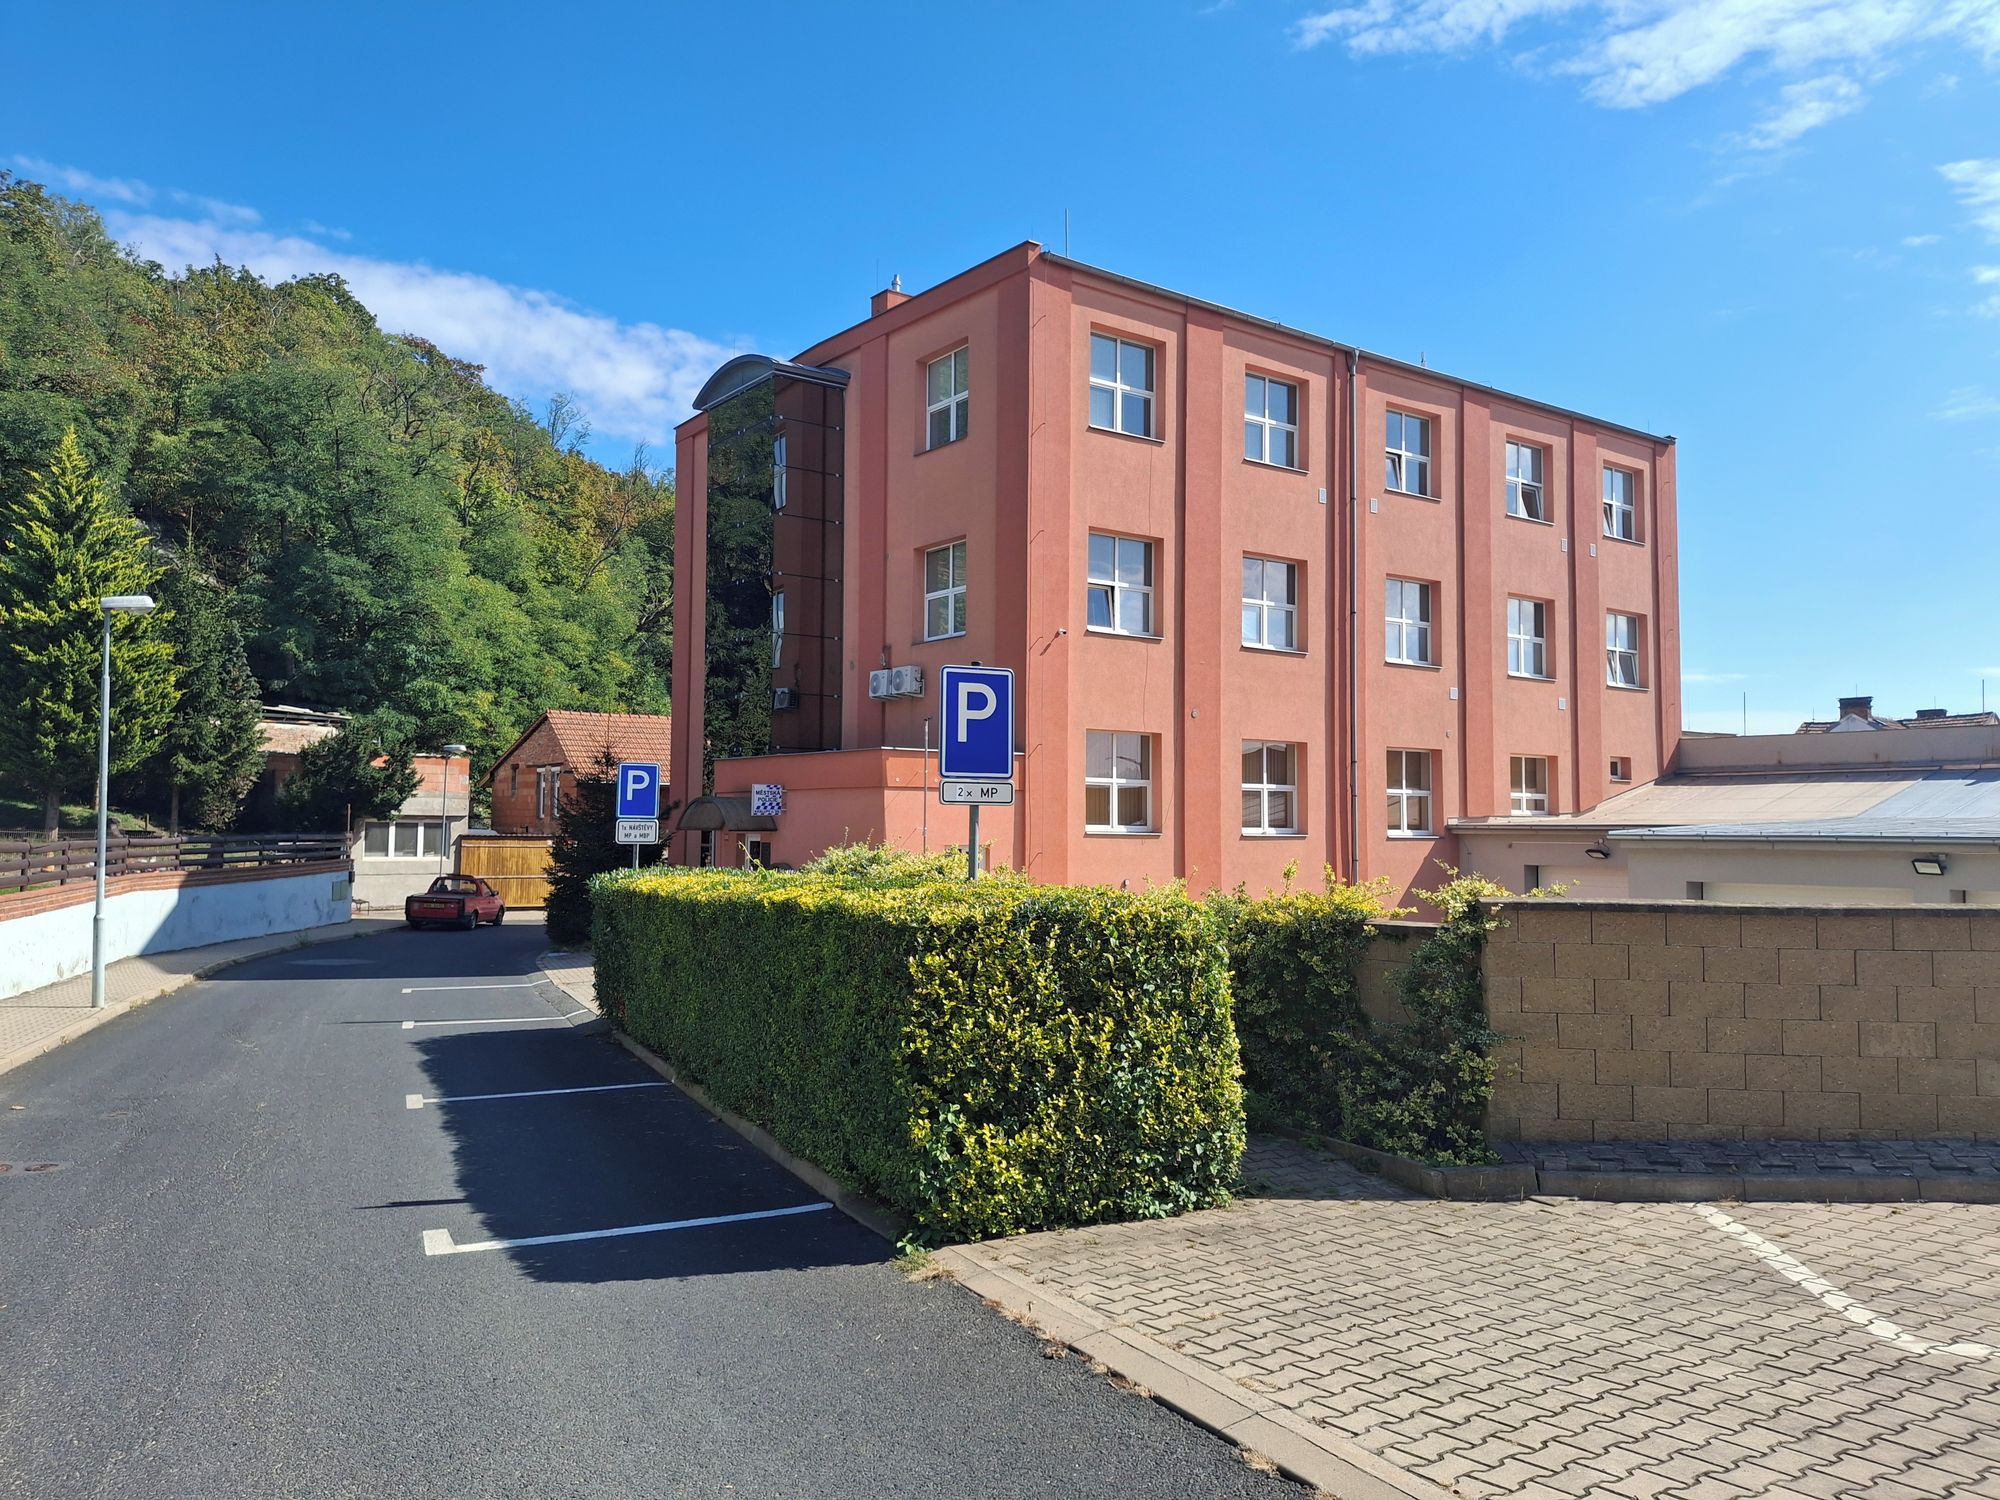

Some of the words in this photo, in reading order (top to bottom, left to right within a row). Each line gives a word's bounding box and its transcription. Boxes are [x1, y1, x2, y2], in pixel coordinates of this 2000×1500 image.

[957, 681, 997, 743] P
[626, 770, 650, 800] P
[980, 787, 998, 799] MP
